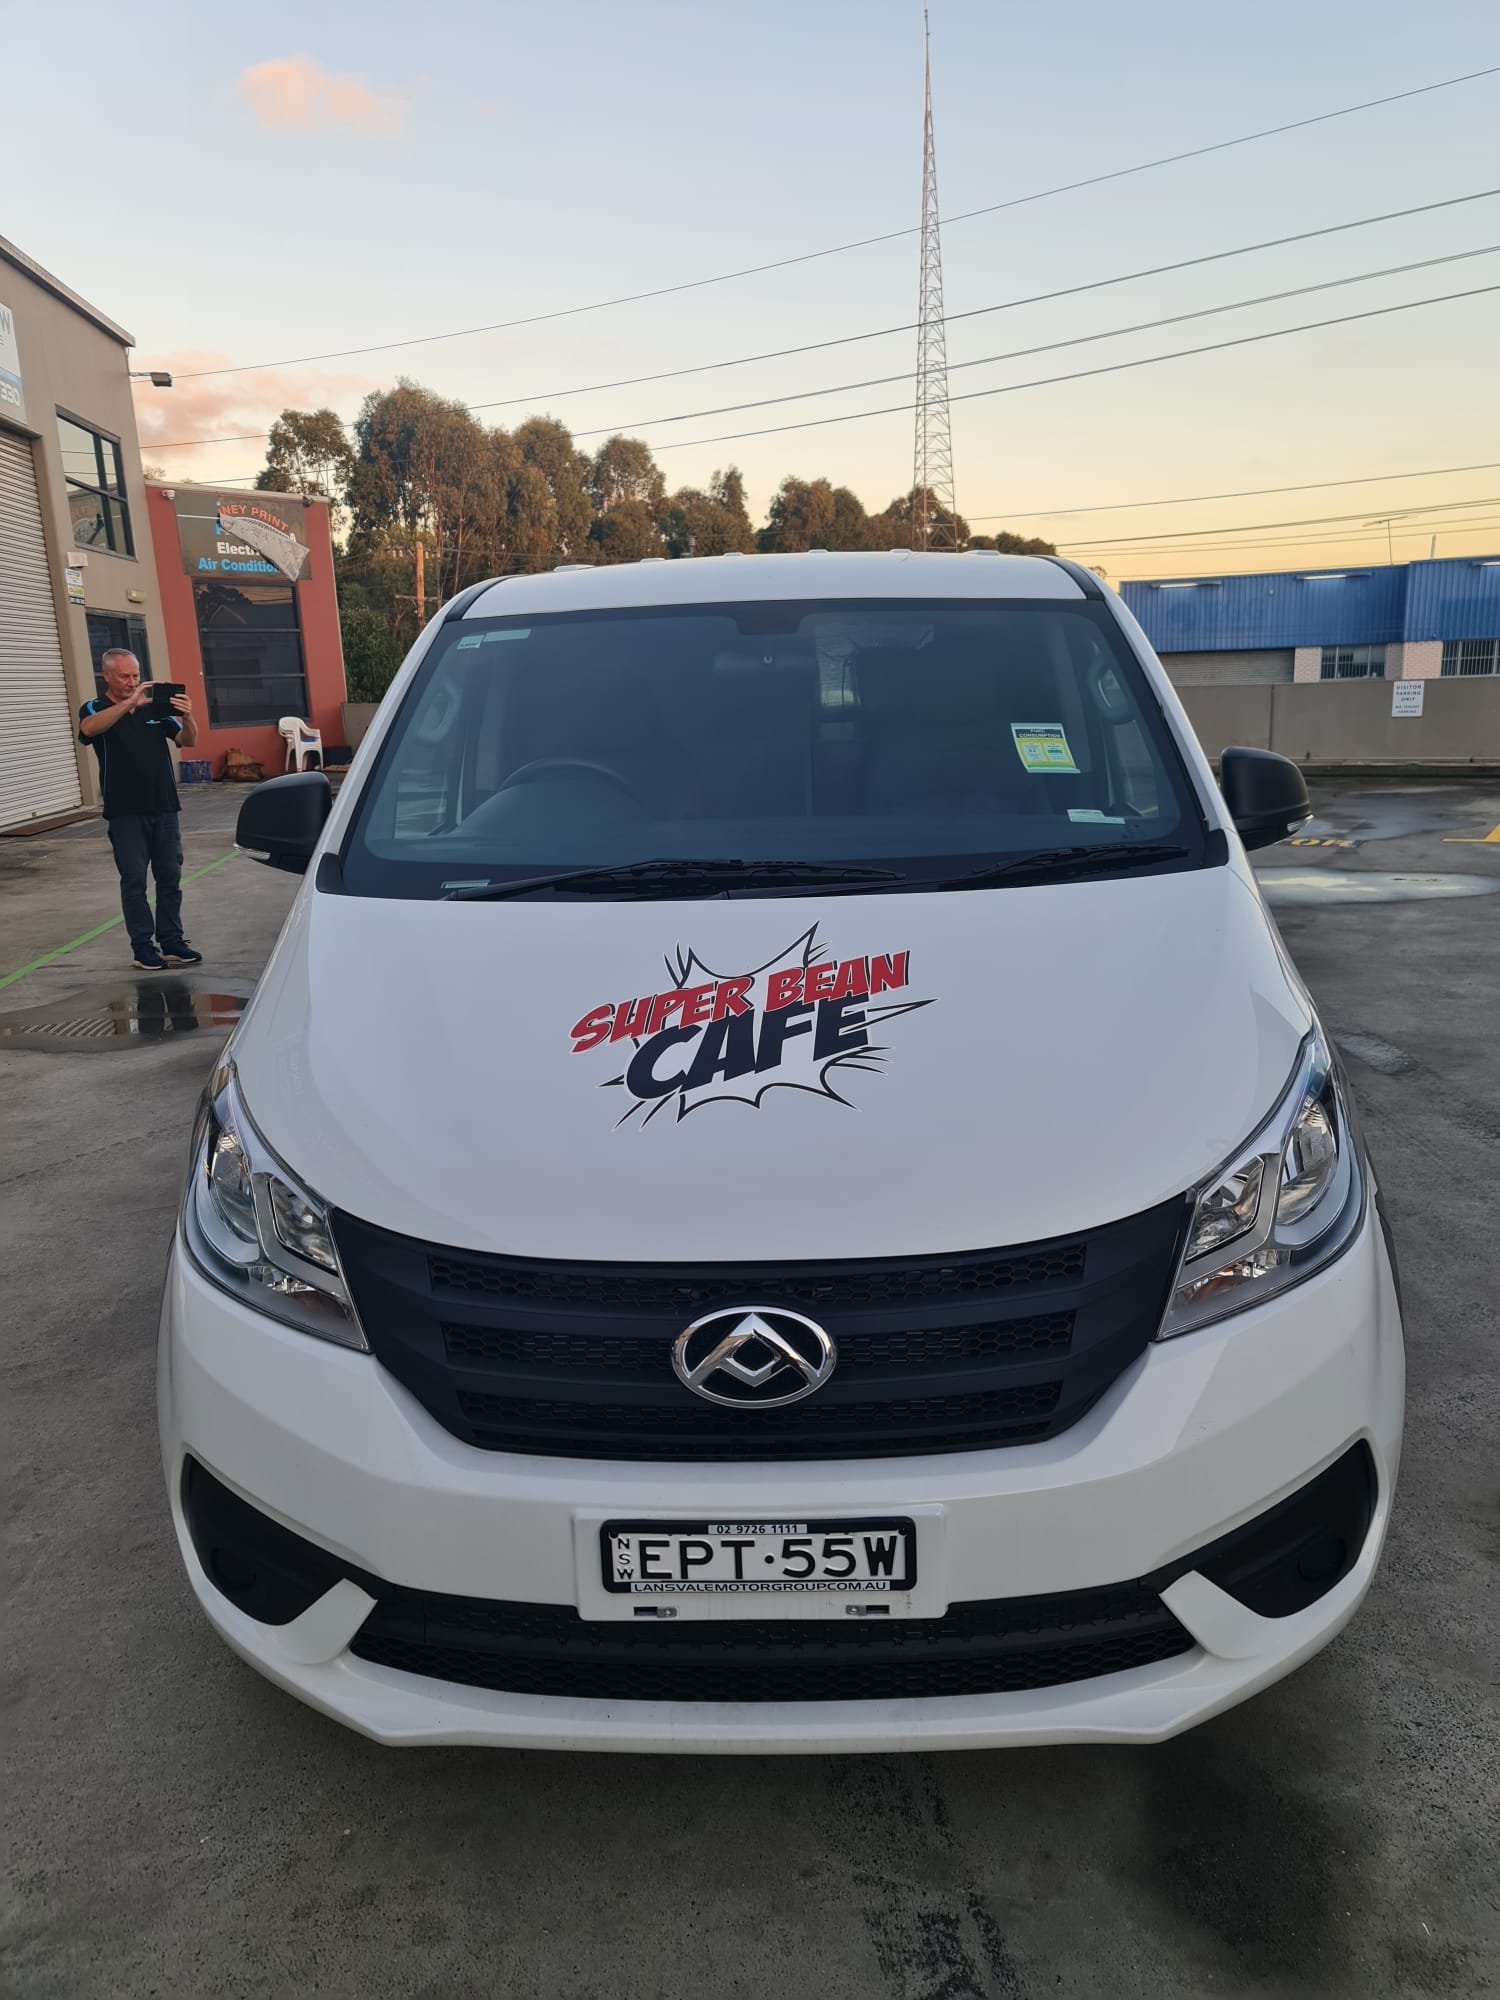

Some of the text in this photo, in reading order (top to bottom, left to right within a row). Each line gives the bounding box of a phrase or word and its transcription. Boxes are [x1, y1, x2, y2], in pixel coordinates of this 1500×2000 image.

[219, 504, 247, 515] NEY
[251, 507, 289, 531] PRINT
[198, 556, 279, 573] Air Conditio
[1290, 839, 1353, 848] OR
[570, 950, 911, 1053] SUPER BEAN
[626, 994, 869, 1100] CAFE
[716, 1524, 798, 1534] 02 9726 1111
[634, 1582, 886, 1592] LANSVALEMOTORGROUP.COM.AU
